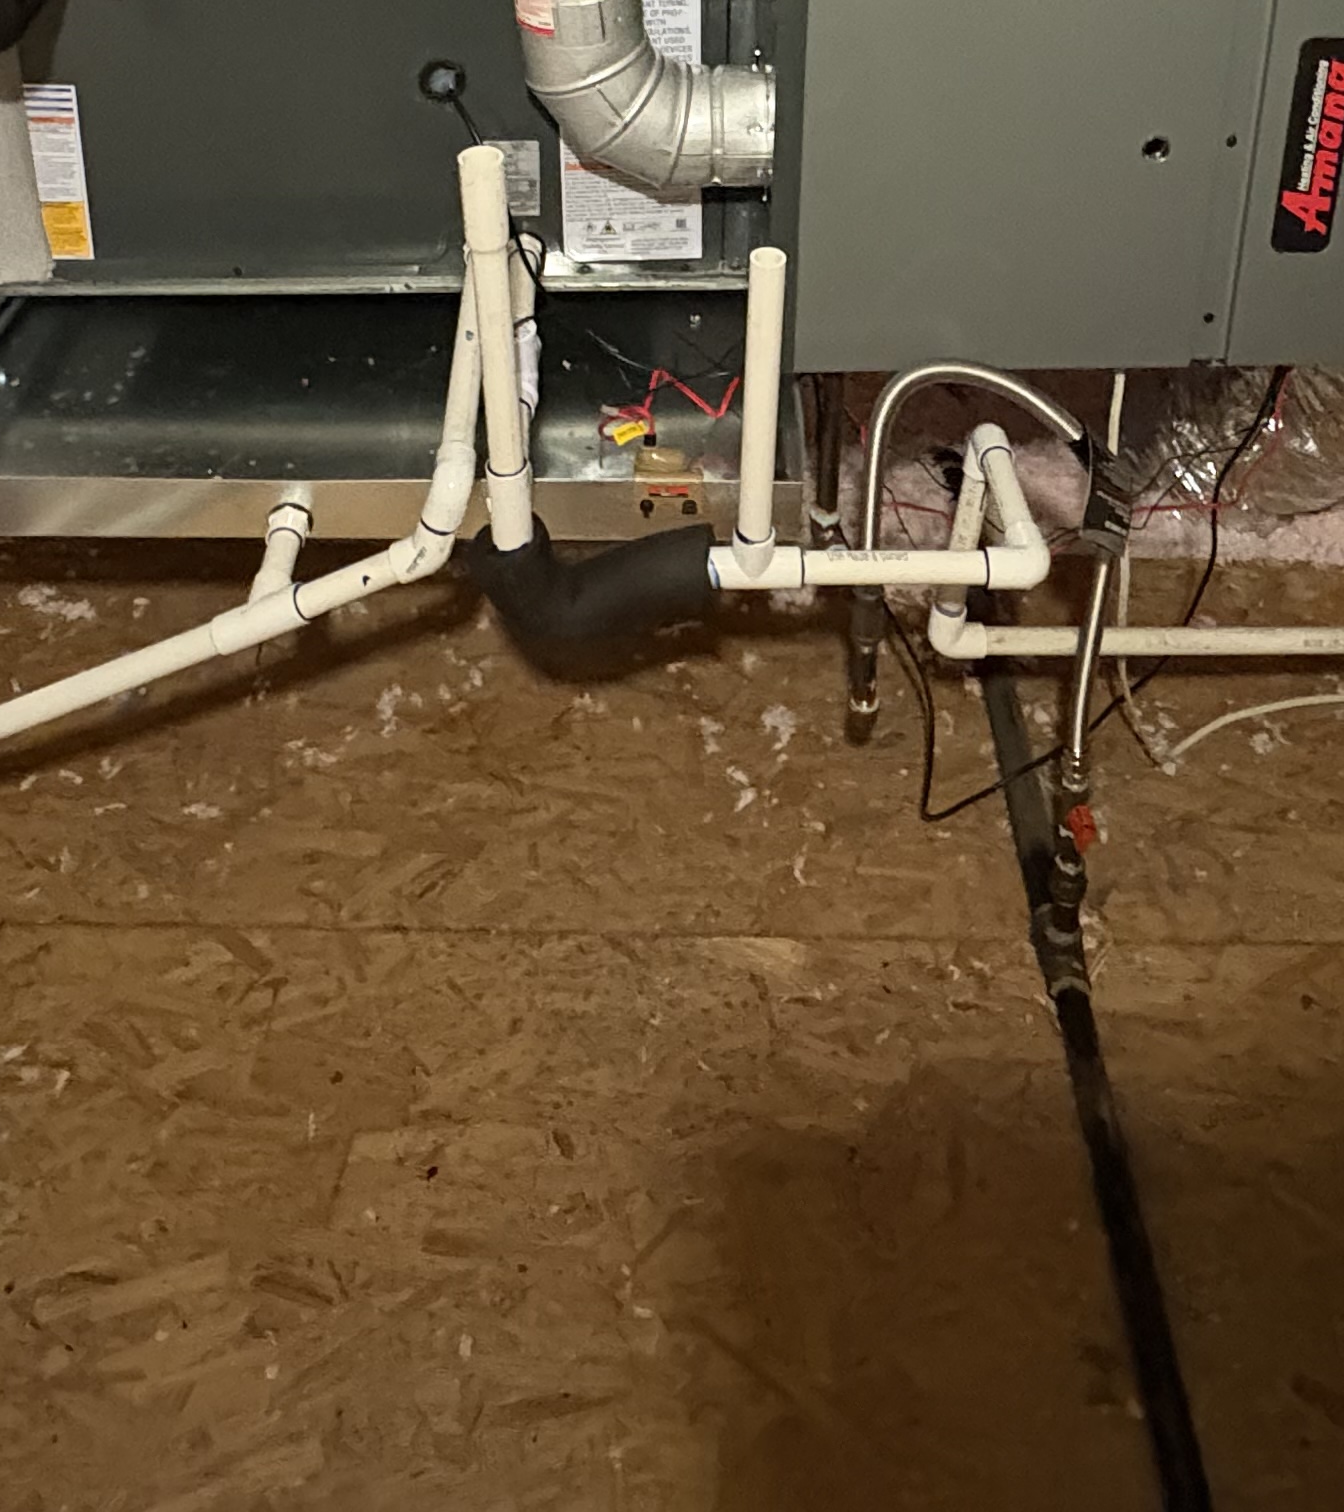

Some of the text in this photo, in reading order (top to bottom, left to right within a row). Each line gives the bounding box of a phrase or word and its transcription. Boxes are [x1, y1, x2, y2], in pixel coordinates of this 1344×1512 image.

[1307, 59, 1329, 125] Conditioning
[1305, 125, 1317, 142] Air
[1296, 153, 1315, 192] Heating
